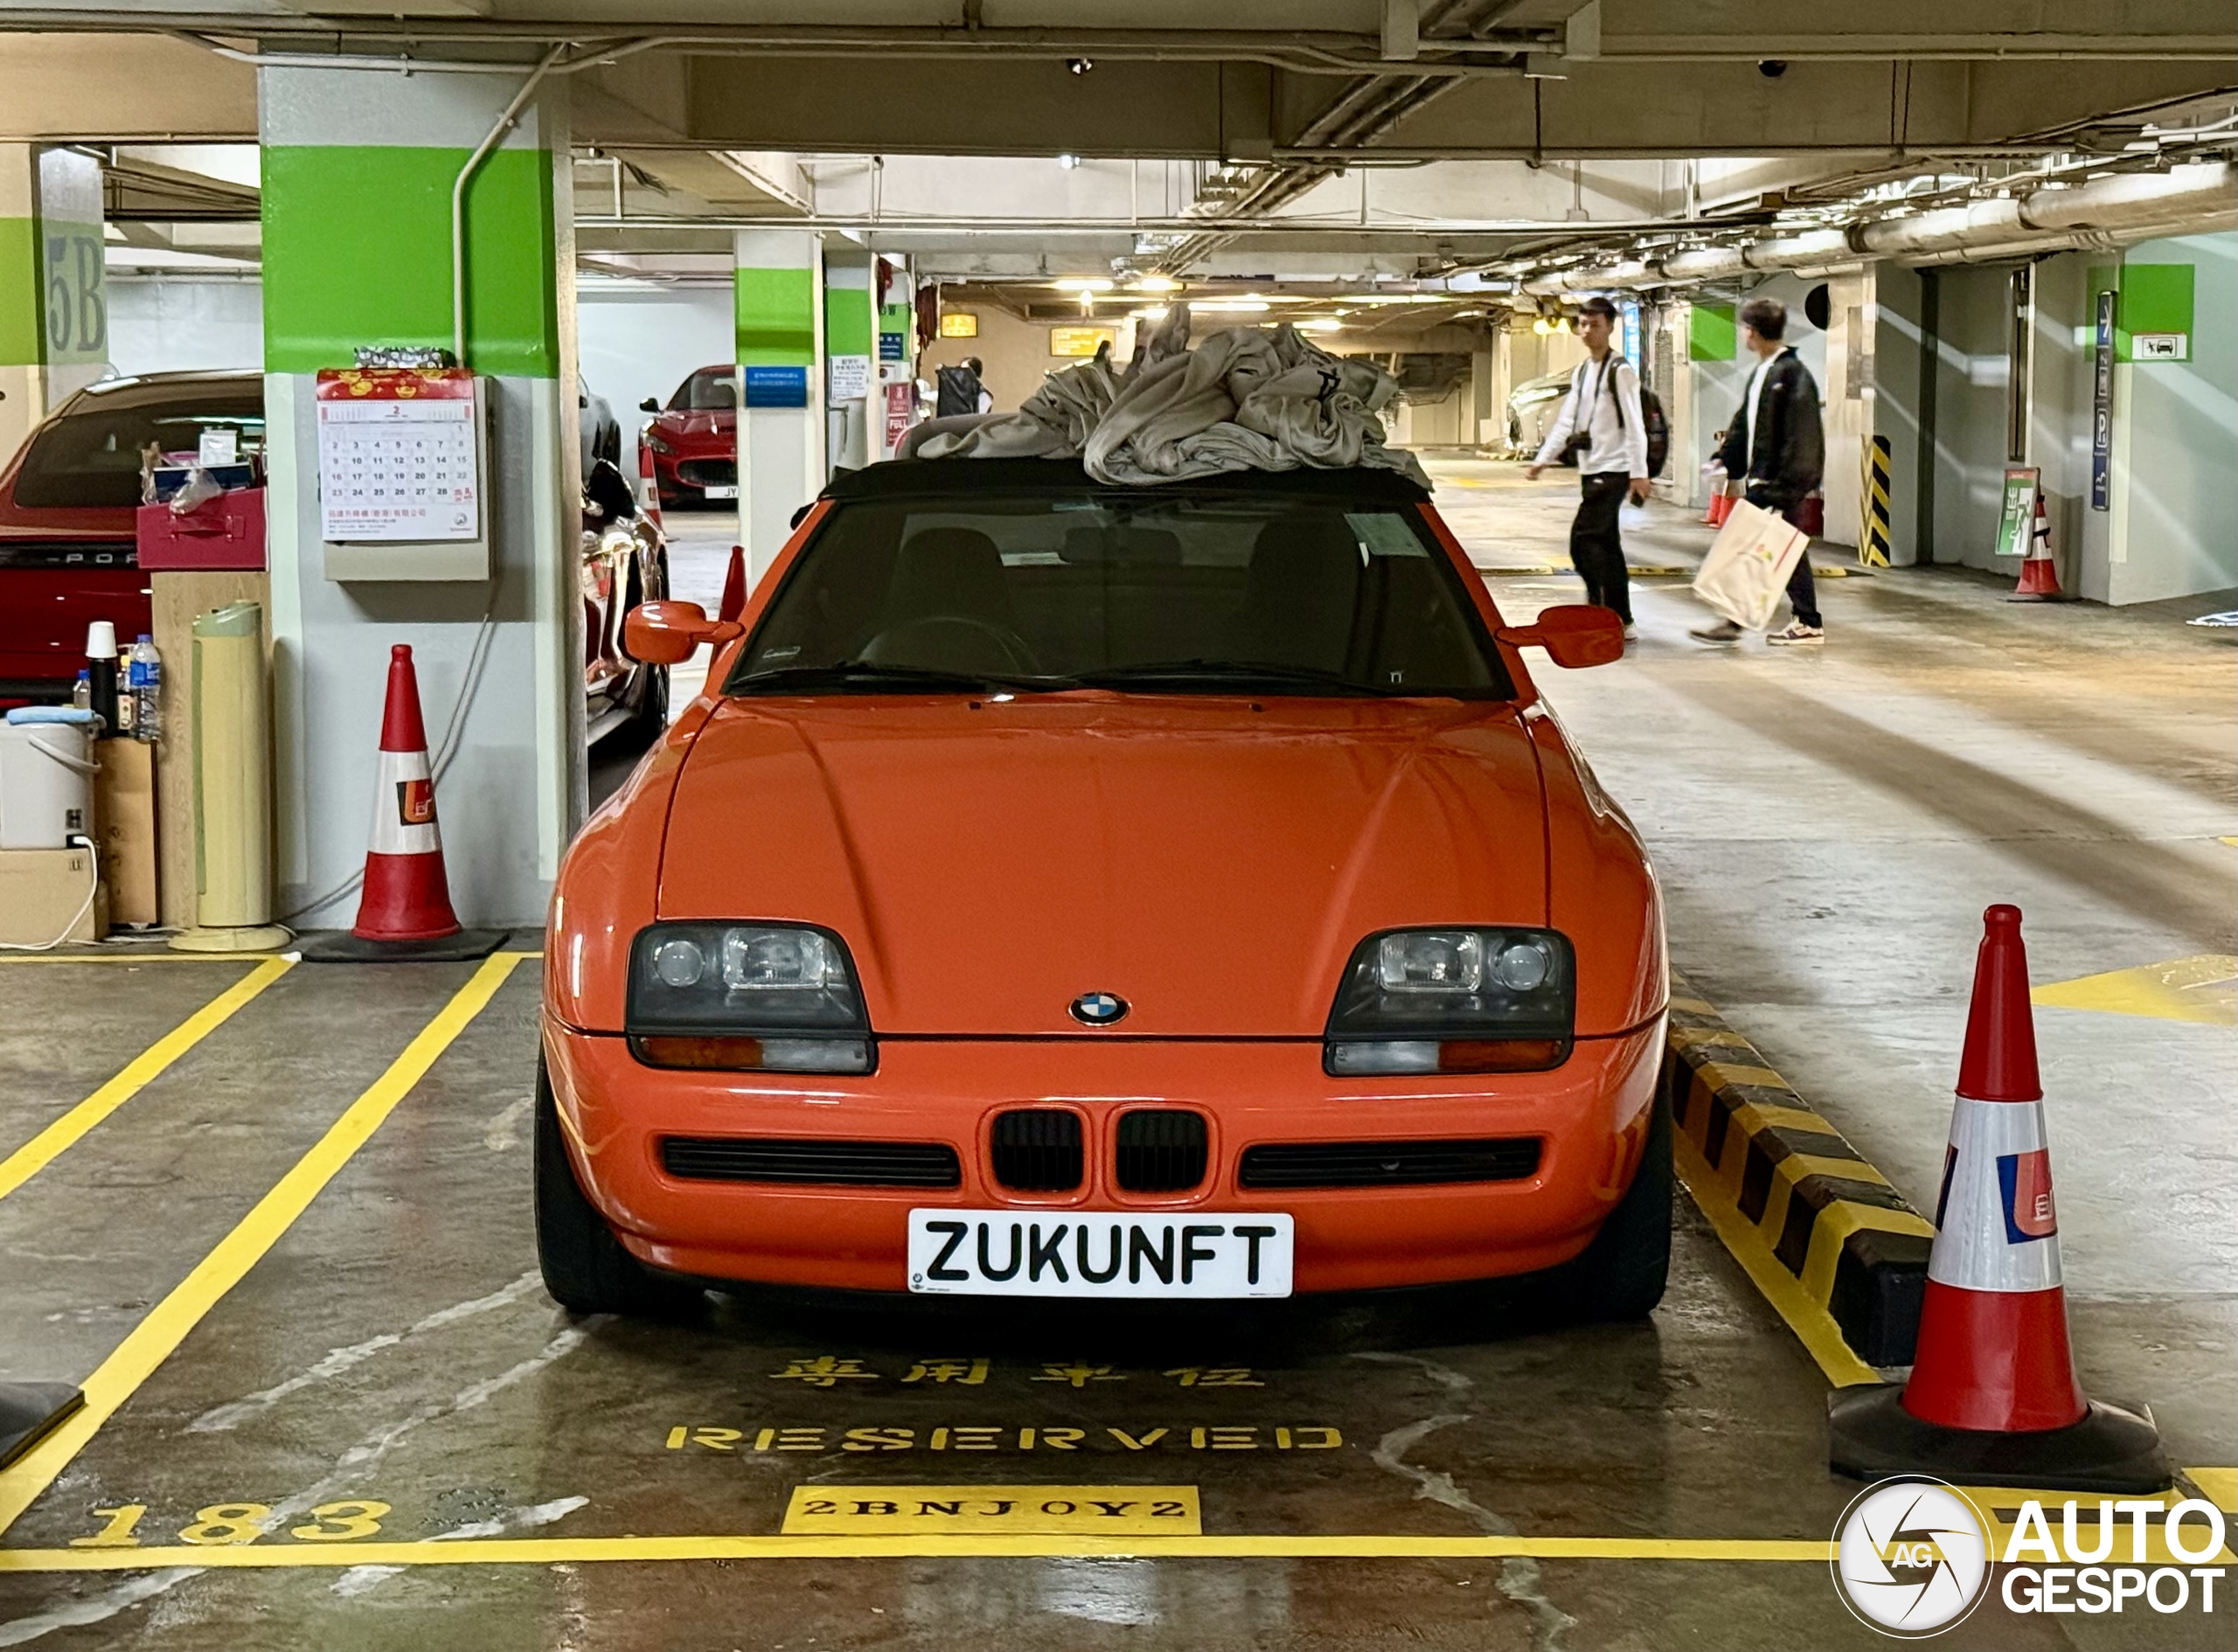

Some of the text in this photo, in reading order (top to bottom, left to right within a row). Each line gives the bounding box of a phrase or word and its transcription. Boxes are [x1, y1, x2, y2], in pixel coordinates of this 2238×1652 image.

[48, 236, 106, 351] 5B
[925, 1221, 1276, 1285] ZUKUNFT
[666, 1426, 1343, 1452] RESERVED
[69, 1500, 392, 1546] 183
